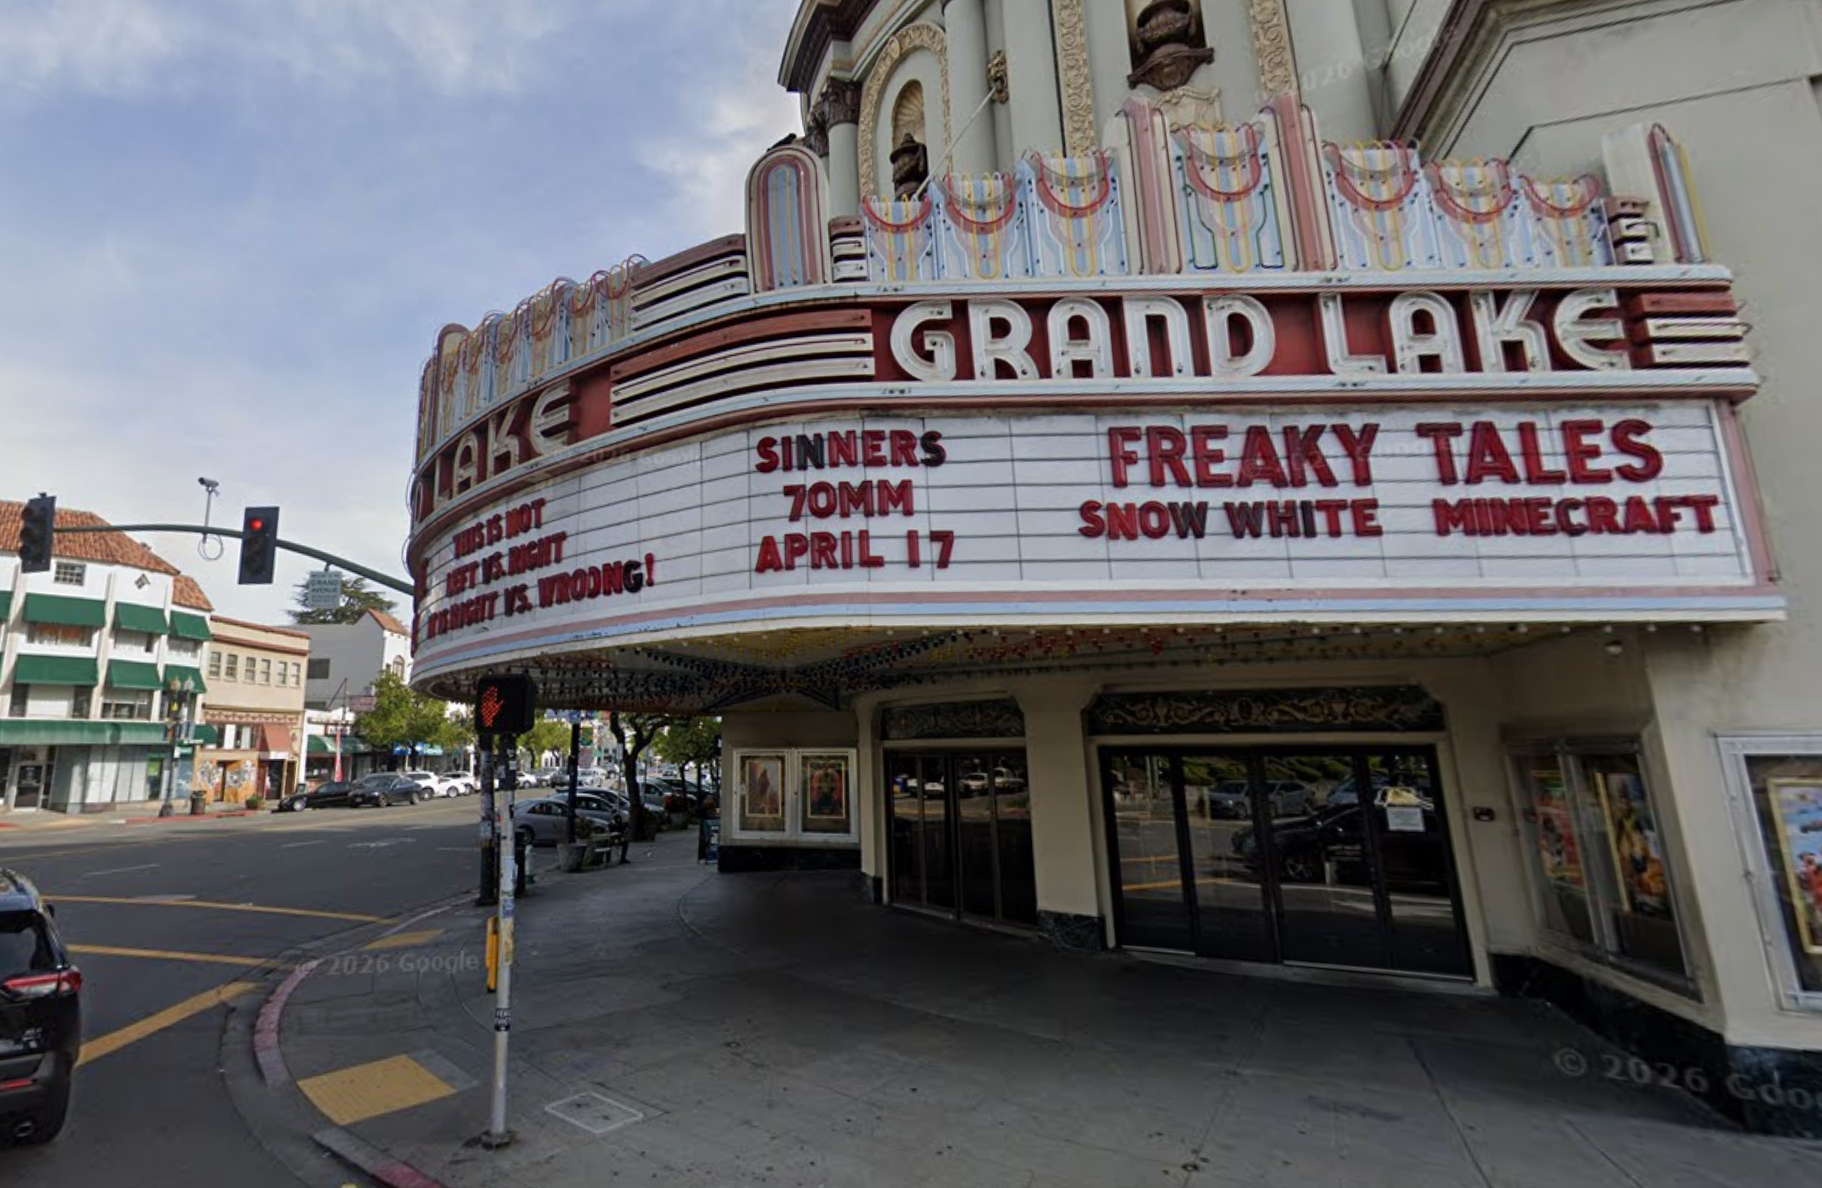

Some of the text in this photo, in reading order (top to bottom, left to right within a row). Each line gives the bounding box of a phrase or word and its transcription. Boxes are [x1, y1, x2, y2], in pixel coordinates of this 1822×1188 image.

[890, 287, 1632, 382] GRAND LAKE
[433, 377, 570, 512] LAKE
[755, 430, 946, 473] SINNERS
[1108, 422, 1380, 488] FREAKY
[1415, 418, 1664, 486] TALES
[486, 513, 503, 546] IS
[505, 498, 546, 539] NOT
[783, 479, 915, 522] 70MM
[1078, 493, 1719, 540] SNOW WHITE MINECRAFT
[446, 561, 479, 598] LEFT
[508, 531, 567, 576] RIGHT
[755, 529, 955, 573] APRIL 17
[504, 583, 533, 617] VS.
